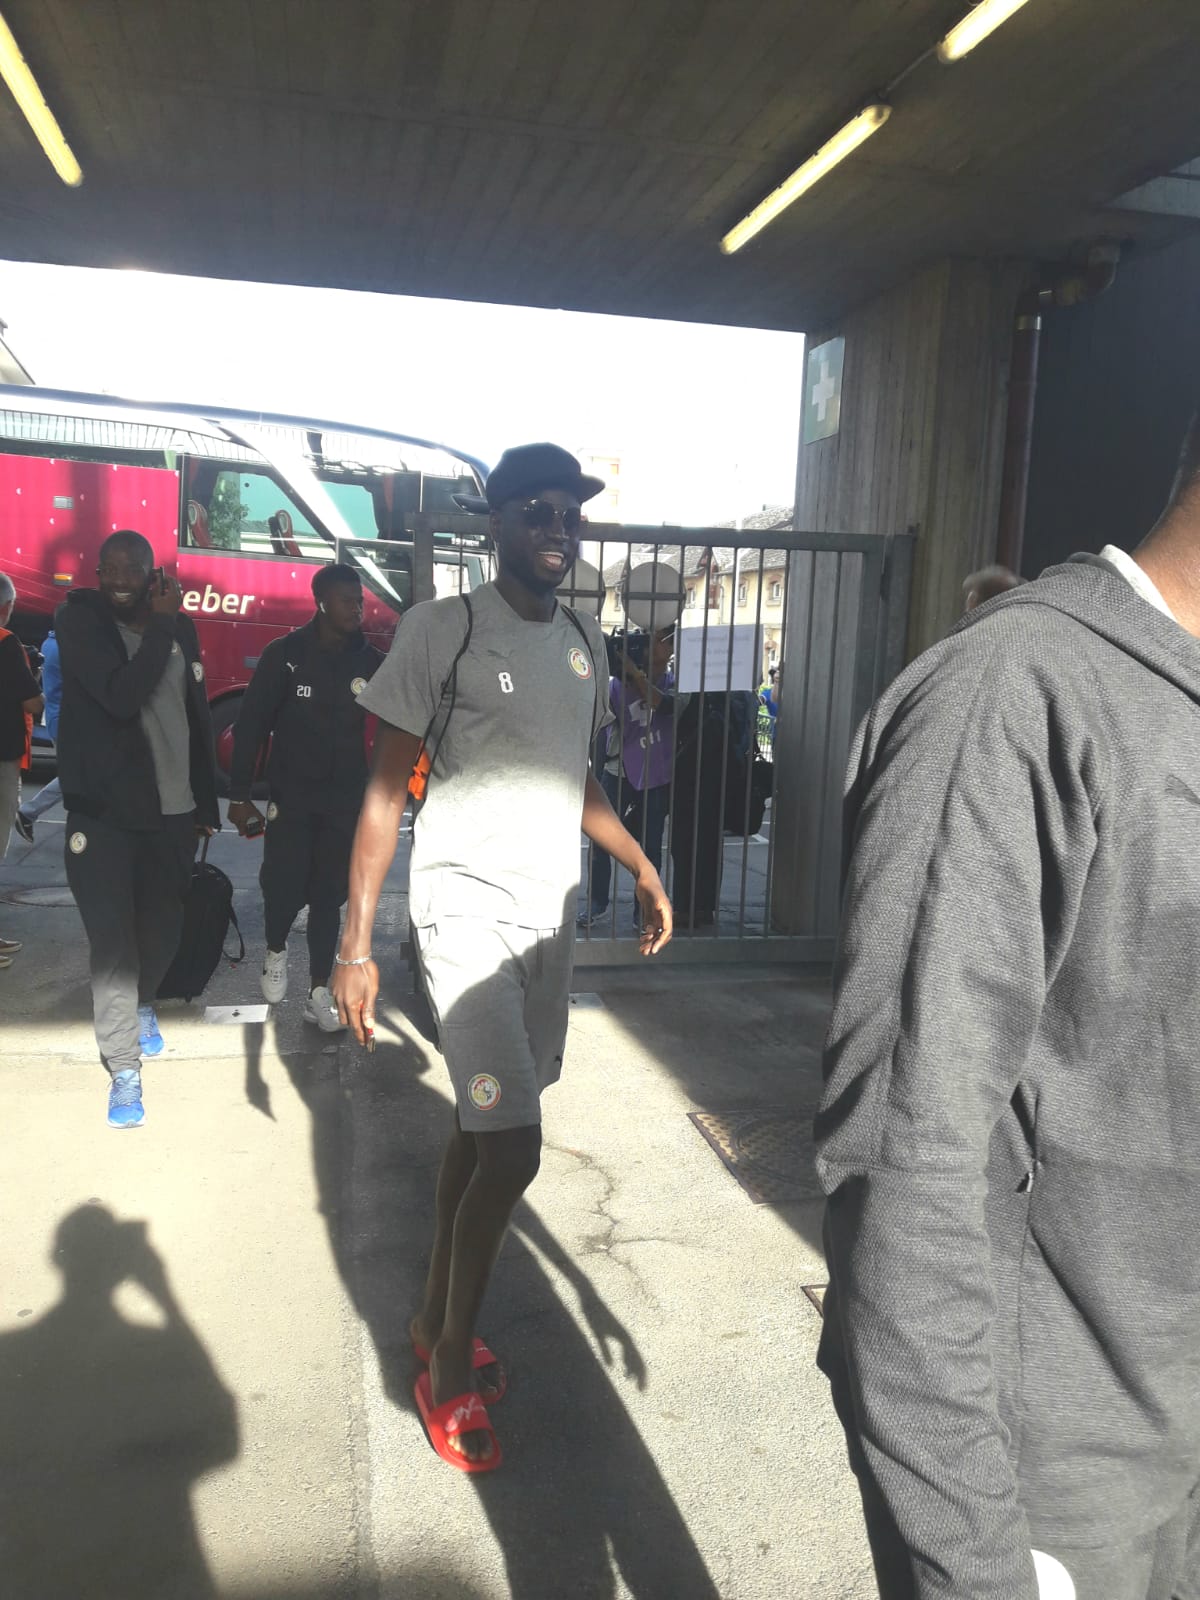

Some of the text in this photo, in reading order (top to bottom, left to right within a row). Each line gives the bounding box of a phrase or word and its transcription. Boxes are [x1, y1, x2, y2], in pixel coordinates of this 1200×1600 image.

[180, 584, 255, 615] eber
[296, 685, 312, 698] 20
[498, 672, 514, 693] 8
